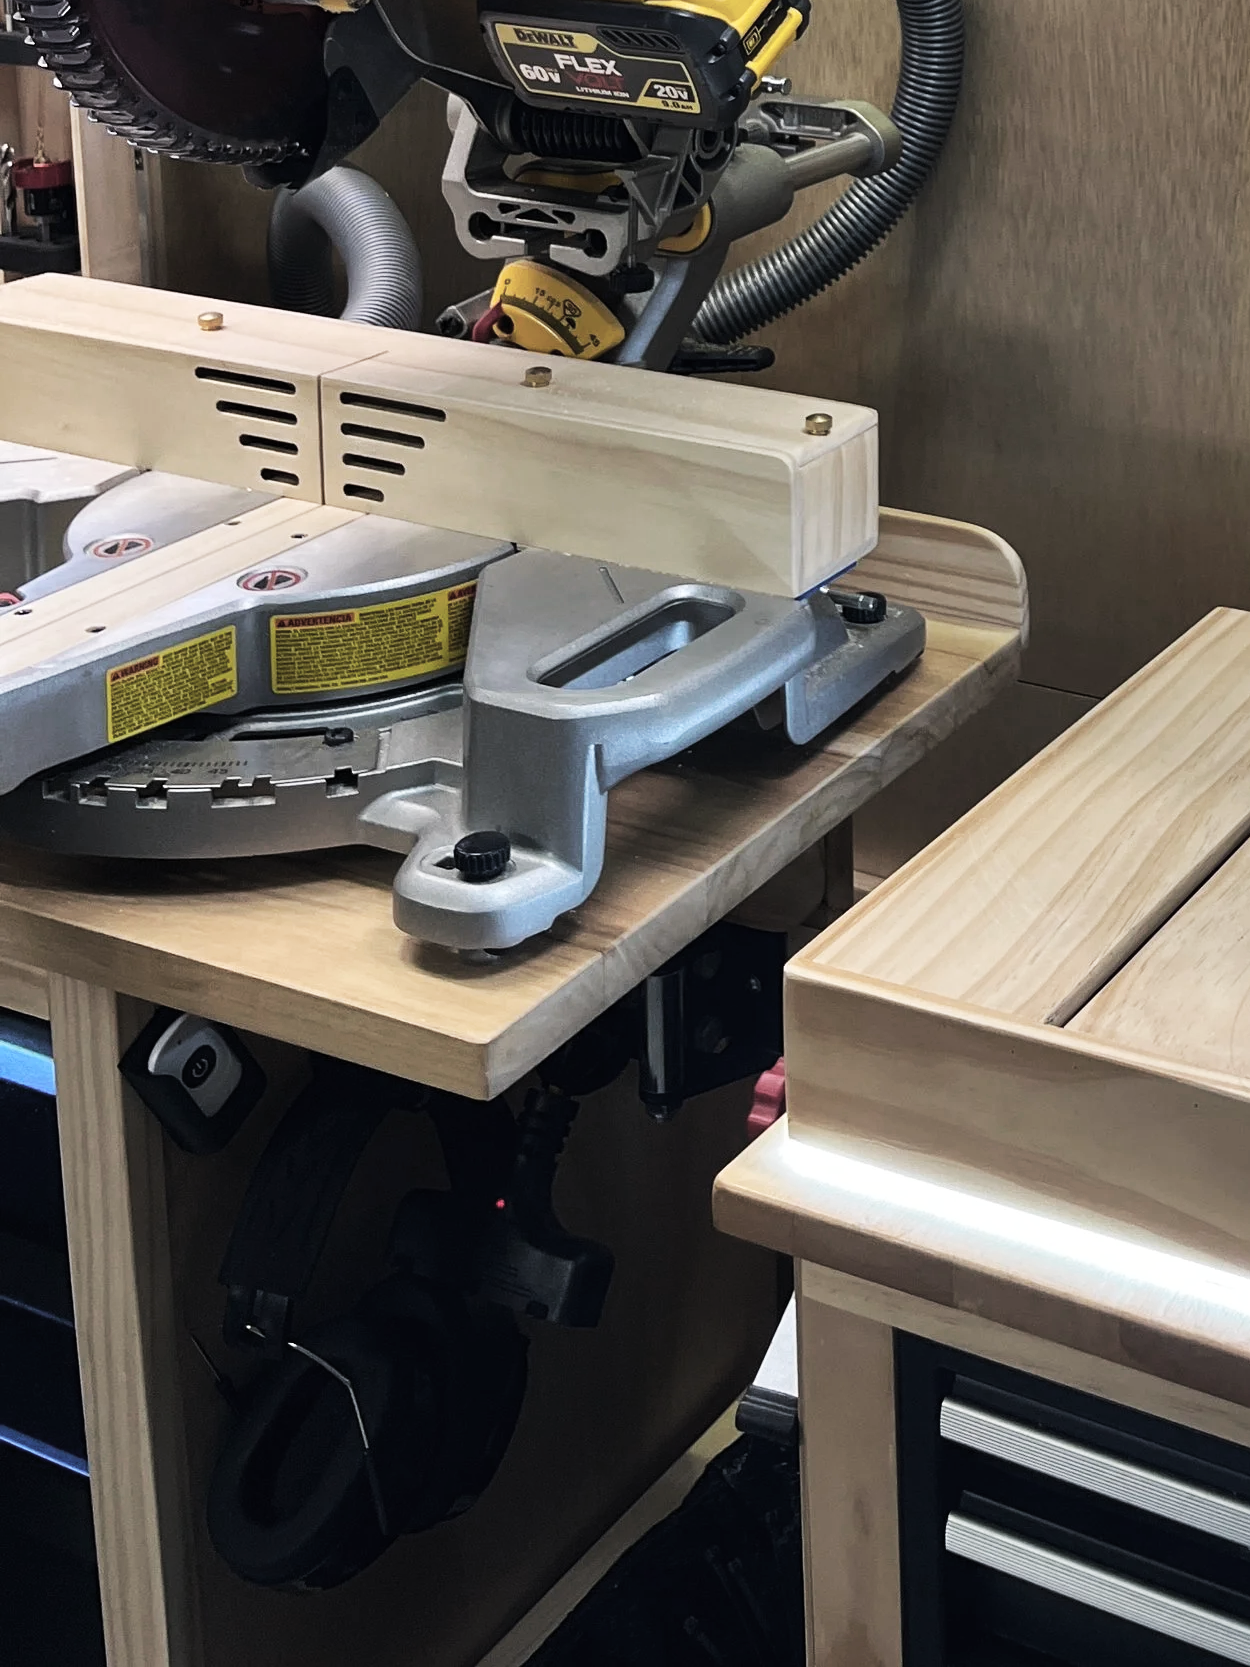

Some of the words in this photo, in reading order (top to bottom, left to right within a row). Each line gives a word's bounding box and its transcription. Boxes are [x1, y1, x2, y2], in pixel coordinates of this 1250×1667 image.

[514, 28, 575, 48] DEWALT
[553, 53, 622, 77] FLEX
[564, 70, 625, 91] VOLT
[576, 86, 612, 97] LITHIUM
[288, 614, 353, 628] ADVERTENCIA
